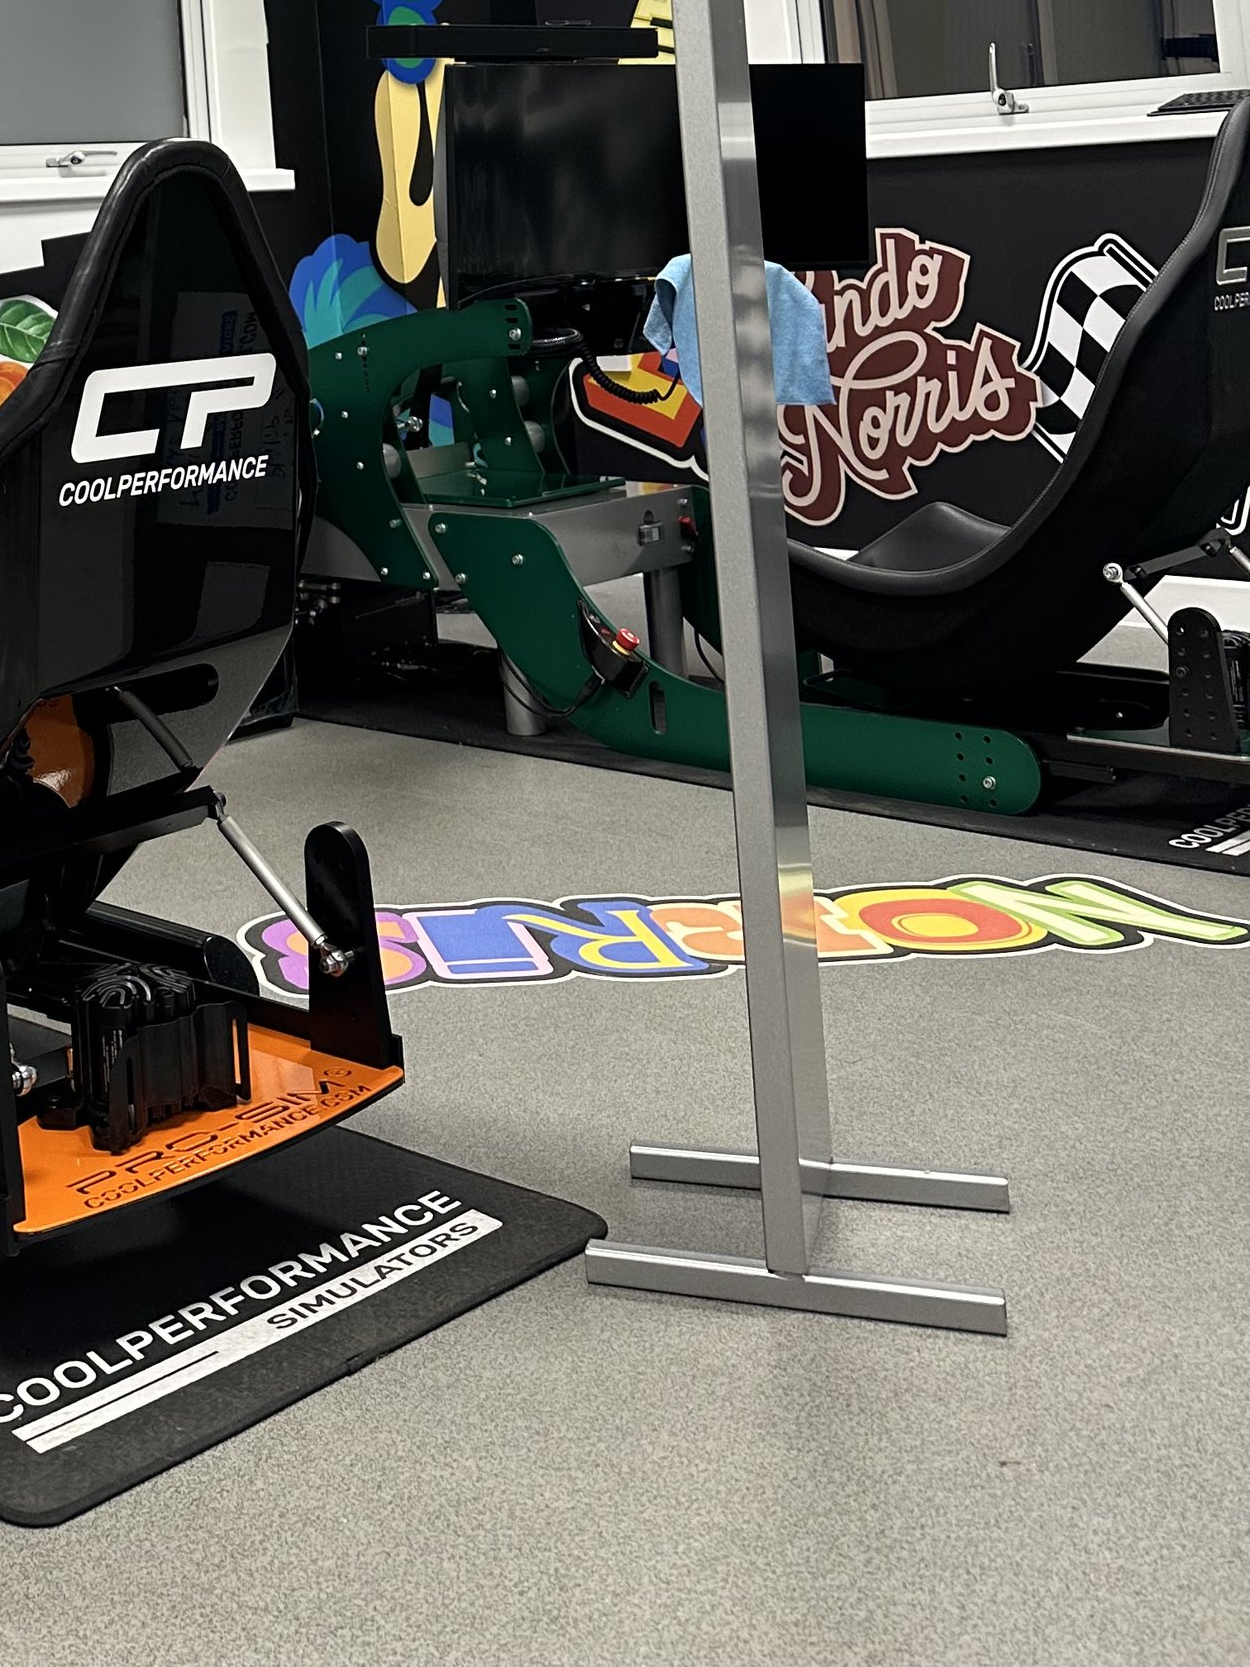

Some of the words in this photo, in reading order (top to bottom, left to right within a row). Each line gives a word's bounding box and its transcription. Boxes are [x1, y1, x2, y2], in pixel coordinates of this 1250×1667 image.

[70, 352, 277, 464] CP
[58, 455, 269, 507] COOLPERFORMANCE
[83, 1084, 373, 1209] COOLPERFORMANCE.COM
[266, 1221, 479, 1330] SIMULATORS
